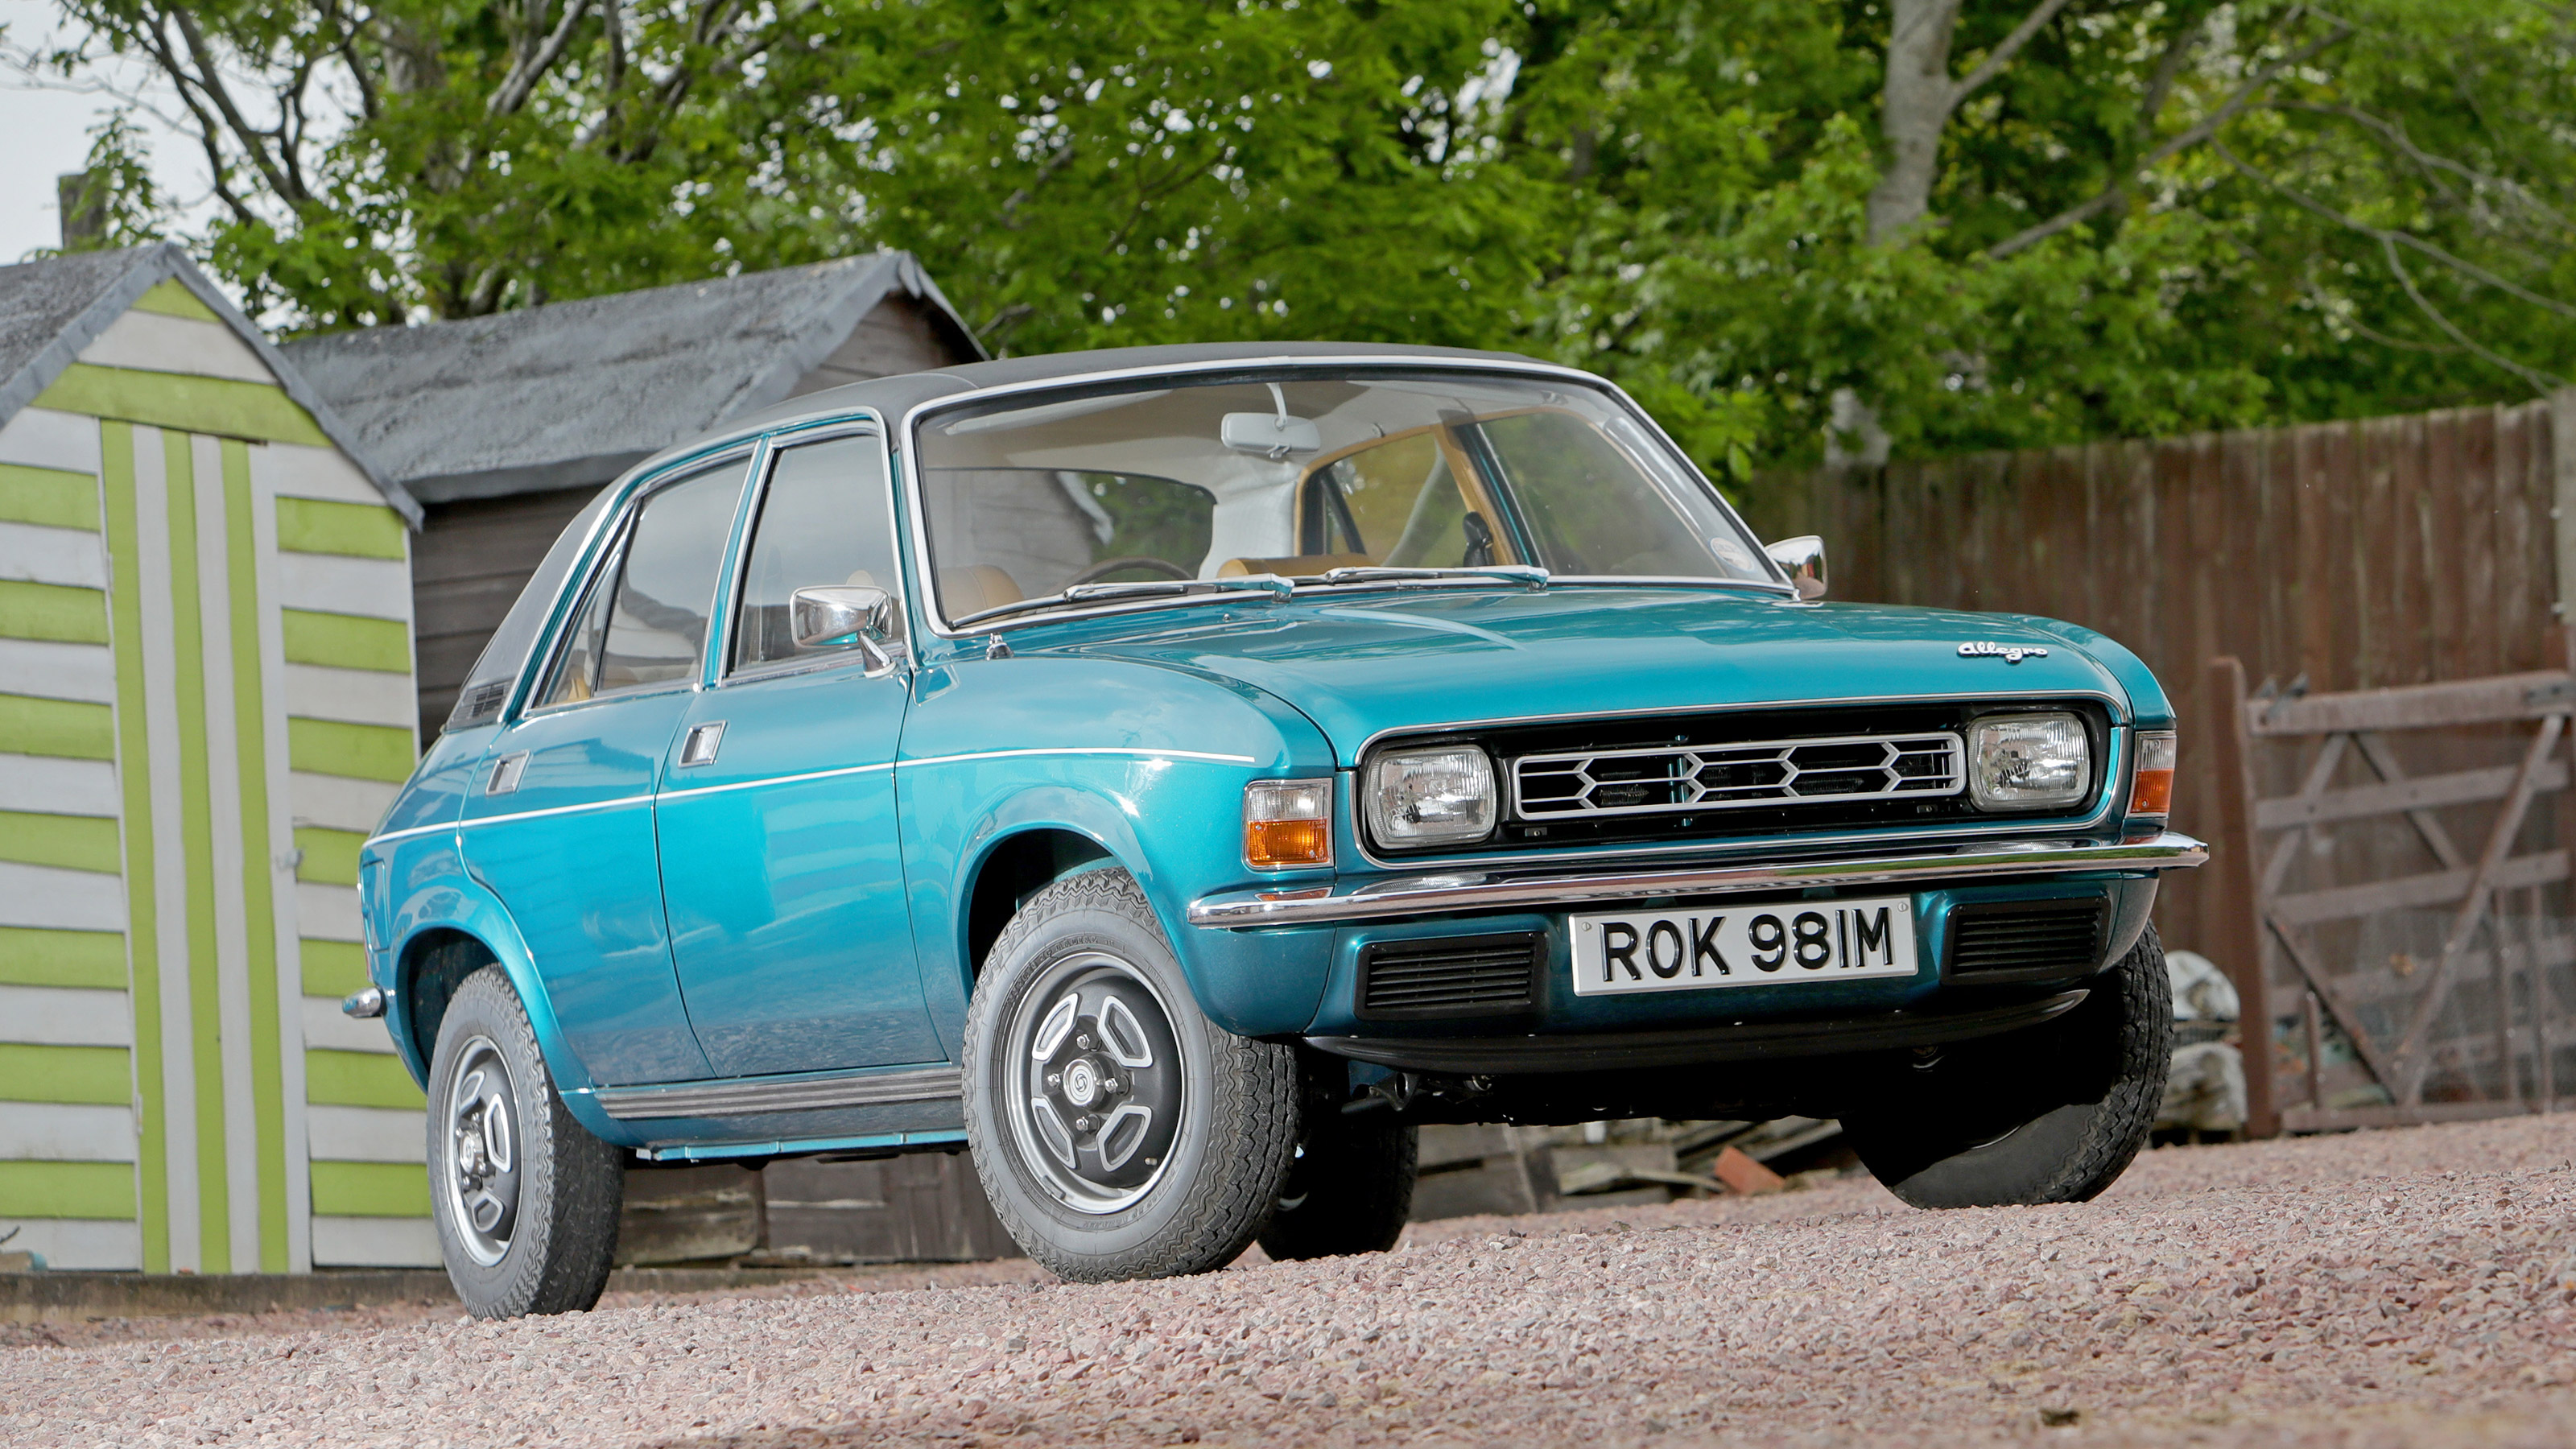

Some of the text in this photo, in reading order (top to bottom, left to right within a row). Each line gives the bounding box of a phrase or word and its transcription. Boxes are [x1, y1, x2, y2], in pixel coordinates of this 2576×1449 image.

[1957, 642, 2048, 663] Allegro
[1599, 906, 1893, 982] ROK 981M
